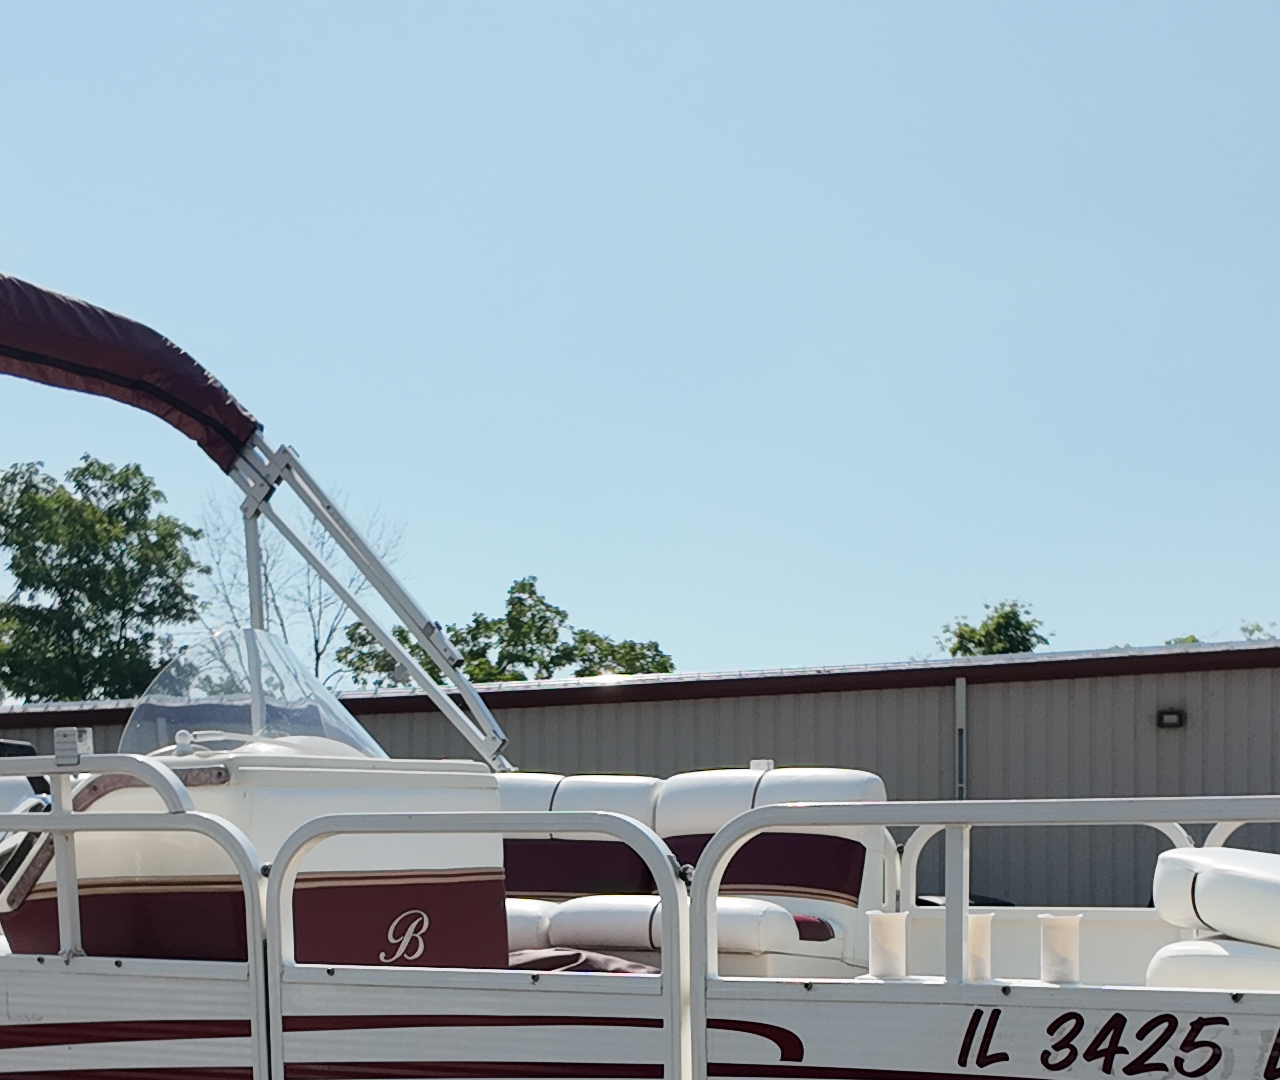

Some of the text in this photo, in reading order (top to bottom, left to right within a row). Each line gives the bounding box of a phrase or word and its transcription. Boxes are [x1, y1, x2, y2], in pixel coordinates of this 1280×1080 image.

[379, 909, 430, 963] B
[958, 1008, 1009, 1068] IL
[1040, 1011, 1230, 1078] 3425
